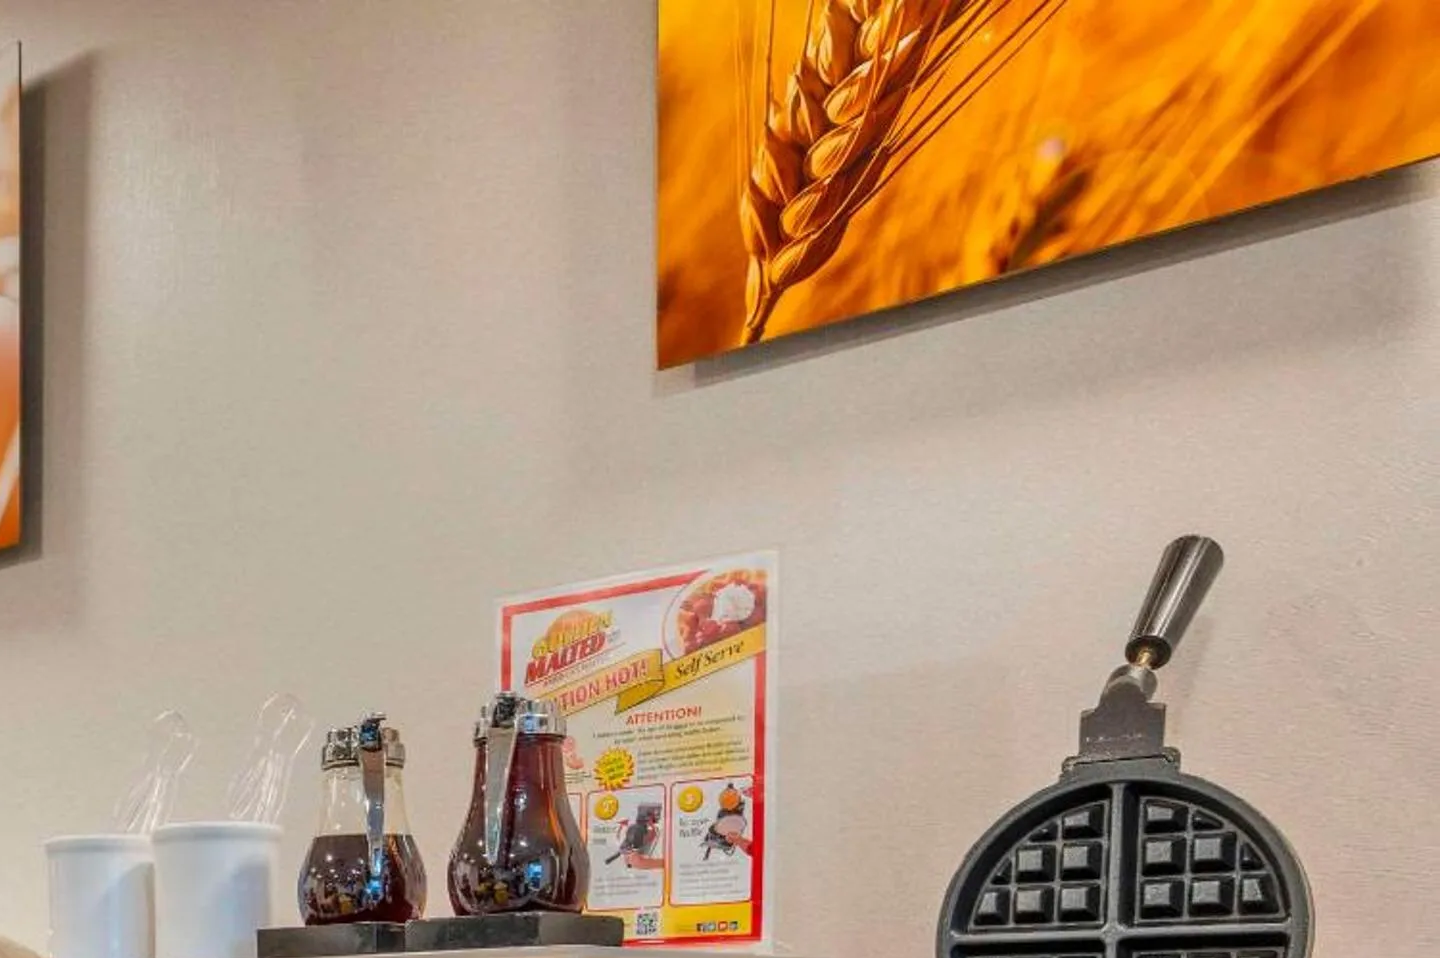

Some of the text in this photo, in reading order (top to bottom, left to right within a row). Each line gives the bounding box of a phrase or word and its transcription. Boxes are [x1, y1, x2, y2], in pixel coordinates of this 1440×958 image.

[524, 631, 606, 684] MALTED
[675, 641, 745, 679] Self Serve
[553, 681, 601, 711] TION
[626, 706, 702, 726] ATTENTION!
